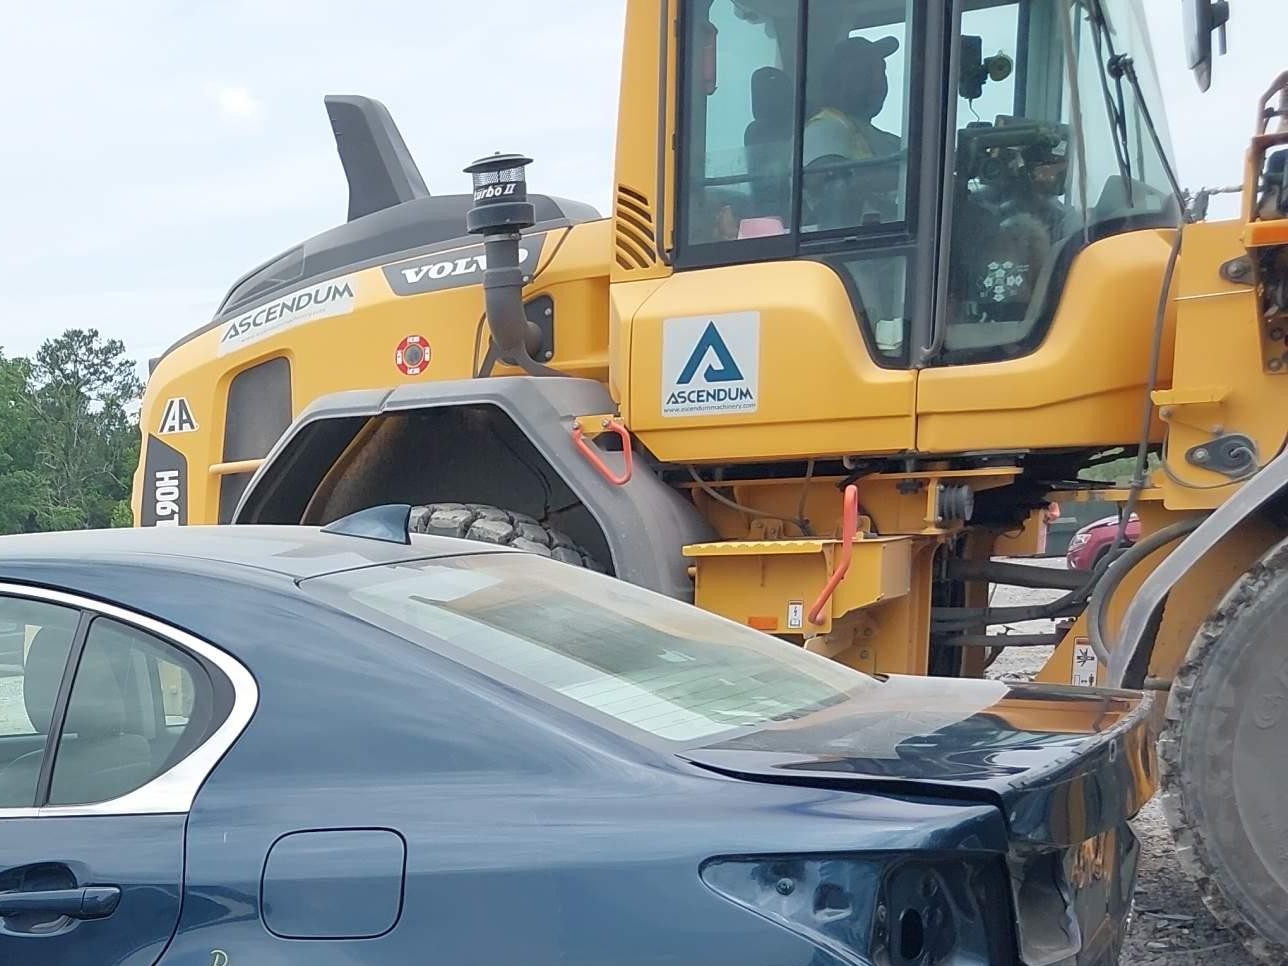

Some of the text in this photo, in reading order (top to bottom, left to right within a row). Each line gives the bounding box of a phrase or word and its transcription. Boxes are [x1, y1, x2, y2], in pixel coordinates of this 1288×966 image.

[474, 185, 502, 200] turbo
[221, 283, 354, 342] ASCENDUM
[666, 387, 754, 405] ASCENDUM
